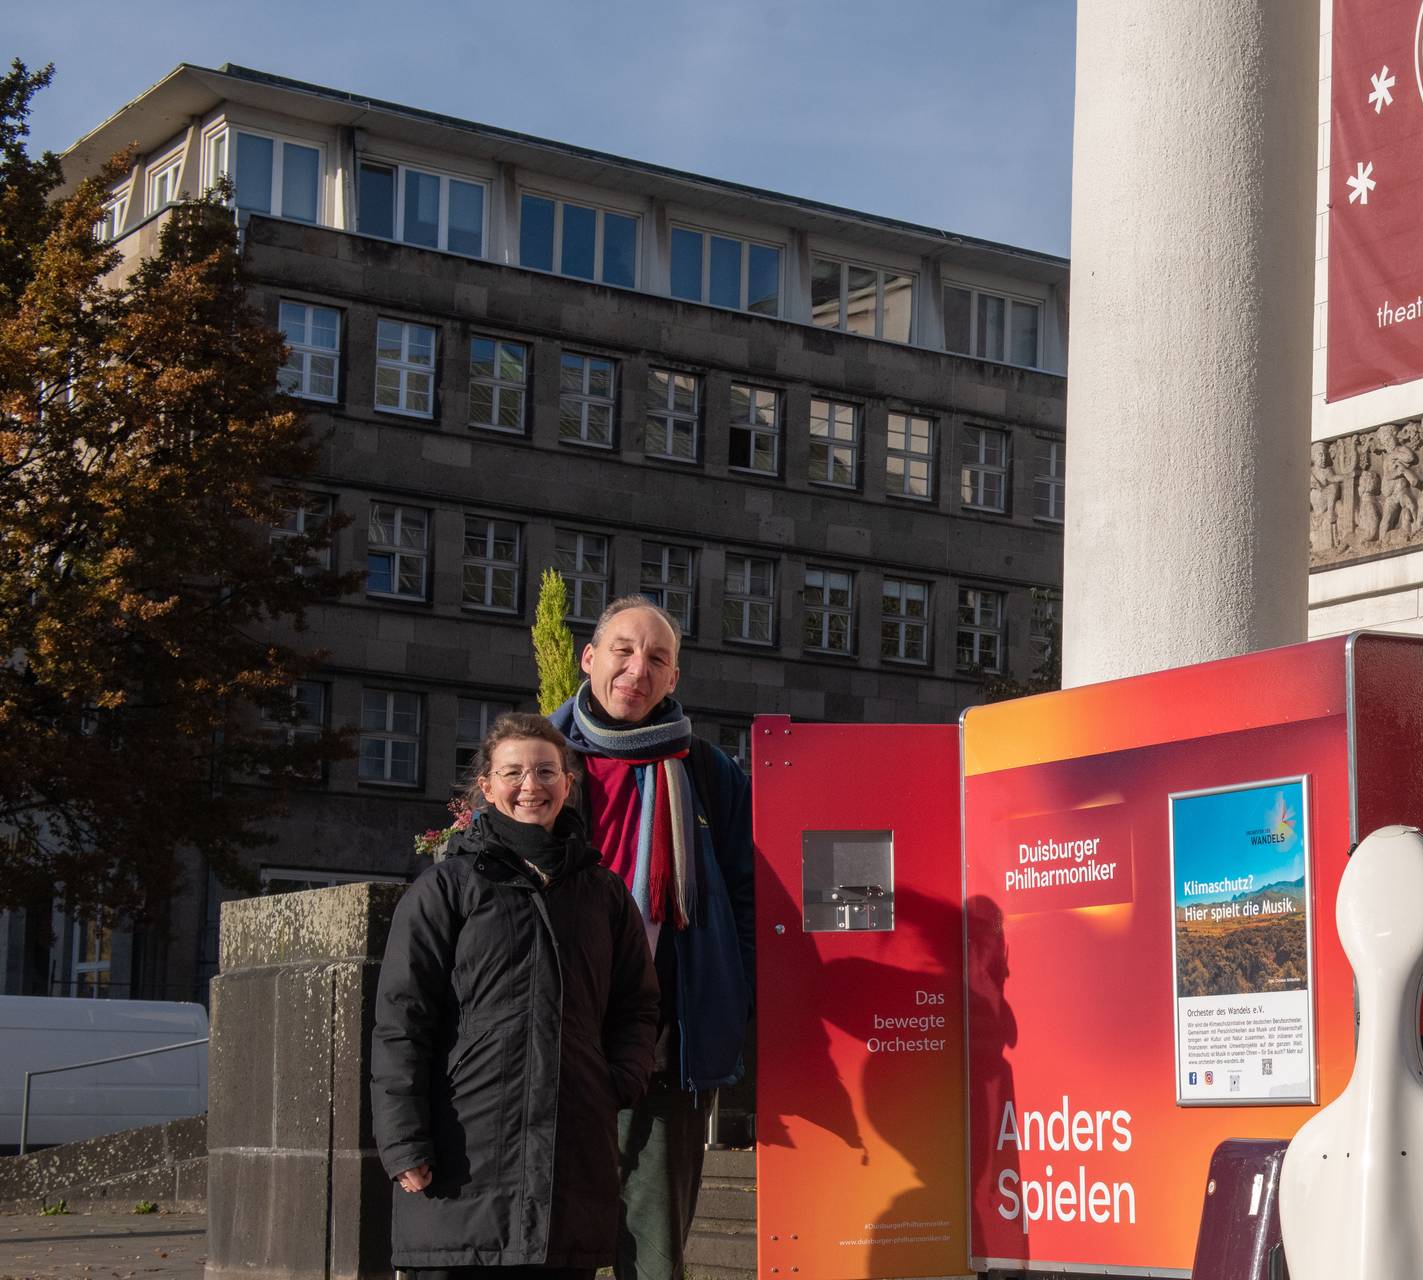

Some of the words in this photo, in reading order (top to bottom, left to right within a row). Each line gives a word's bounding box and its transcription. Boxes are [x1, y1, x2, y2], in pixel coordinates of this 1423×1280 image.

[1250, 832, 1286, 846] WANDELS
[1019, 838, 1100, 864] Duisburger
[1005, 859, 1117, 891] Philharmoniker
[1183, 874, 1254, 896] Klimaschutz?
[1184, 907, 1208, 922] Hier
[1211, 902, 1240, 923] spielt
[1242, 901, 1260, 916] die
[1261, 897, 1297, 915] Musik.
[915, 990, 945, 1006] Das
[874, 1012, 945, 1031] bewegte
[1187, 1008, 1215, 1017] Orchester
[1216, 1008, 1226, 1016] des
[1228, 1006, 1251, 1015] Wandels
[1252, 1005, 1265, 1014] e.V.
[866, 1037, 946, 1053] Orchester
[996, 1095, 1133, 1153] Anders
[997, 1164, 1136, 1234] Spielen
